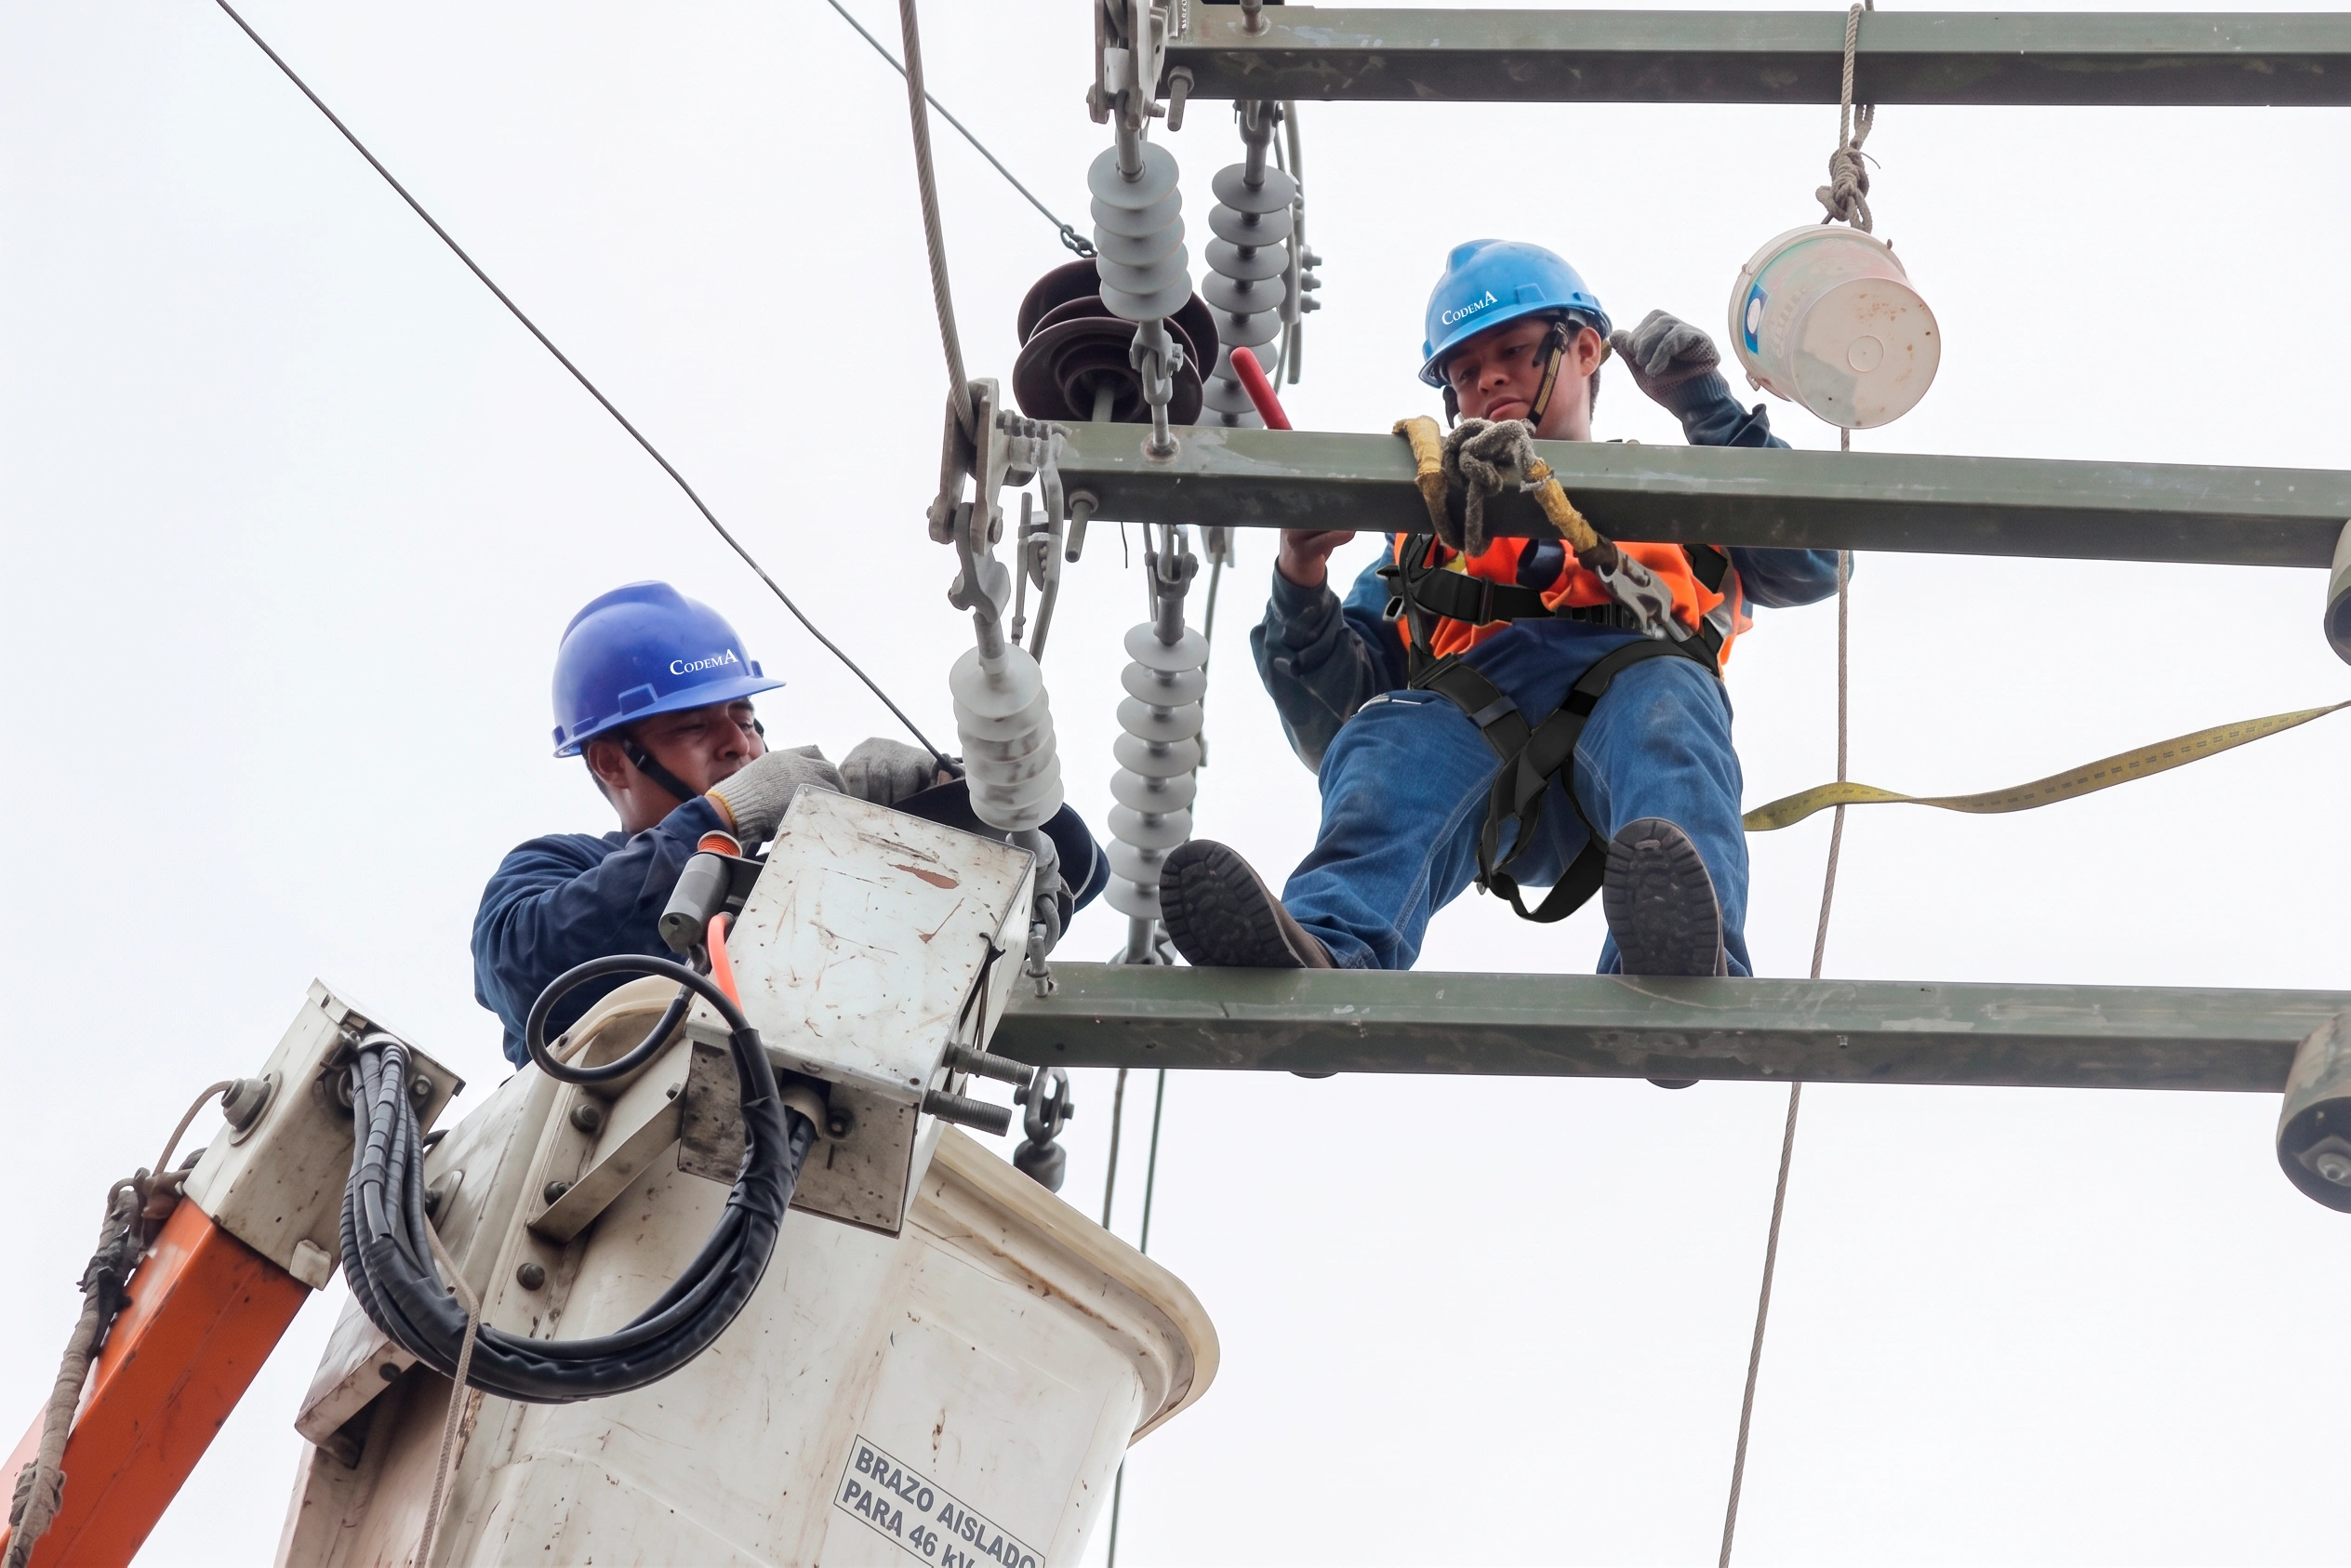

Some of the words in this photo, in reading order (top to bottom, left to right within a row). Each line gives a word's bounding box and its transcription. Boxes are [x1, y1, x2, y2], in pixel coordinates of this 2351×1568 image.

[843, 1478, 903, 1538] PARA
[909, 1524, 938, 1557] 46
[941, 1543, 976, 1568] kV
[855, 1446, 934, 1513] BRAZO
[936, 1502, 1036, 1568] AISLADO
